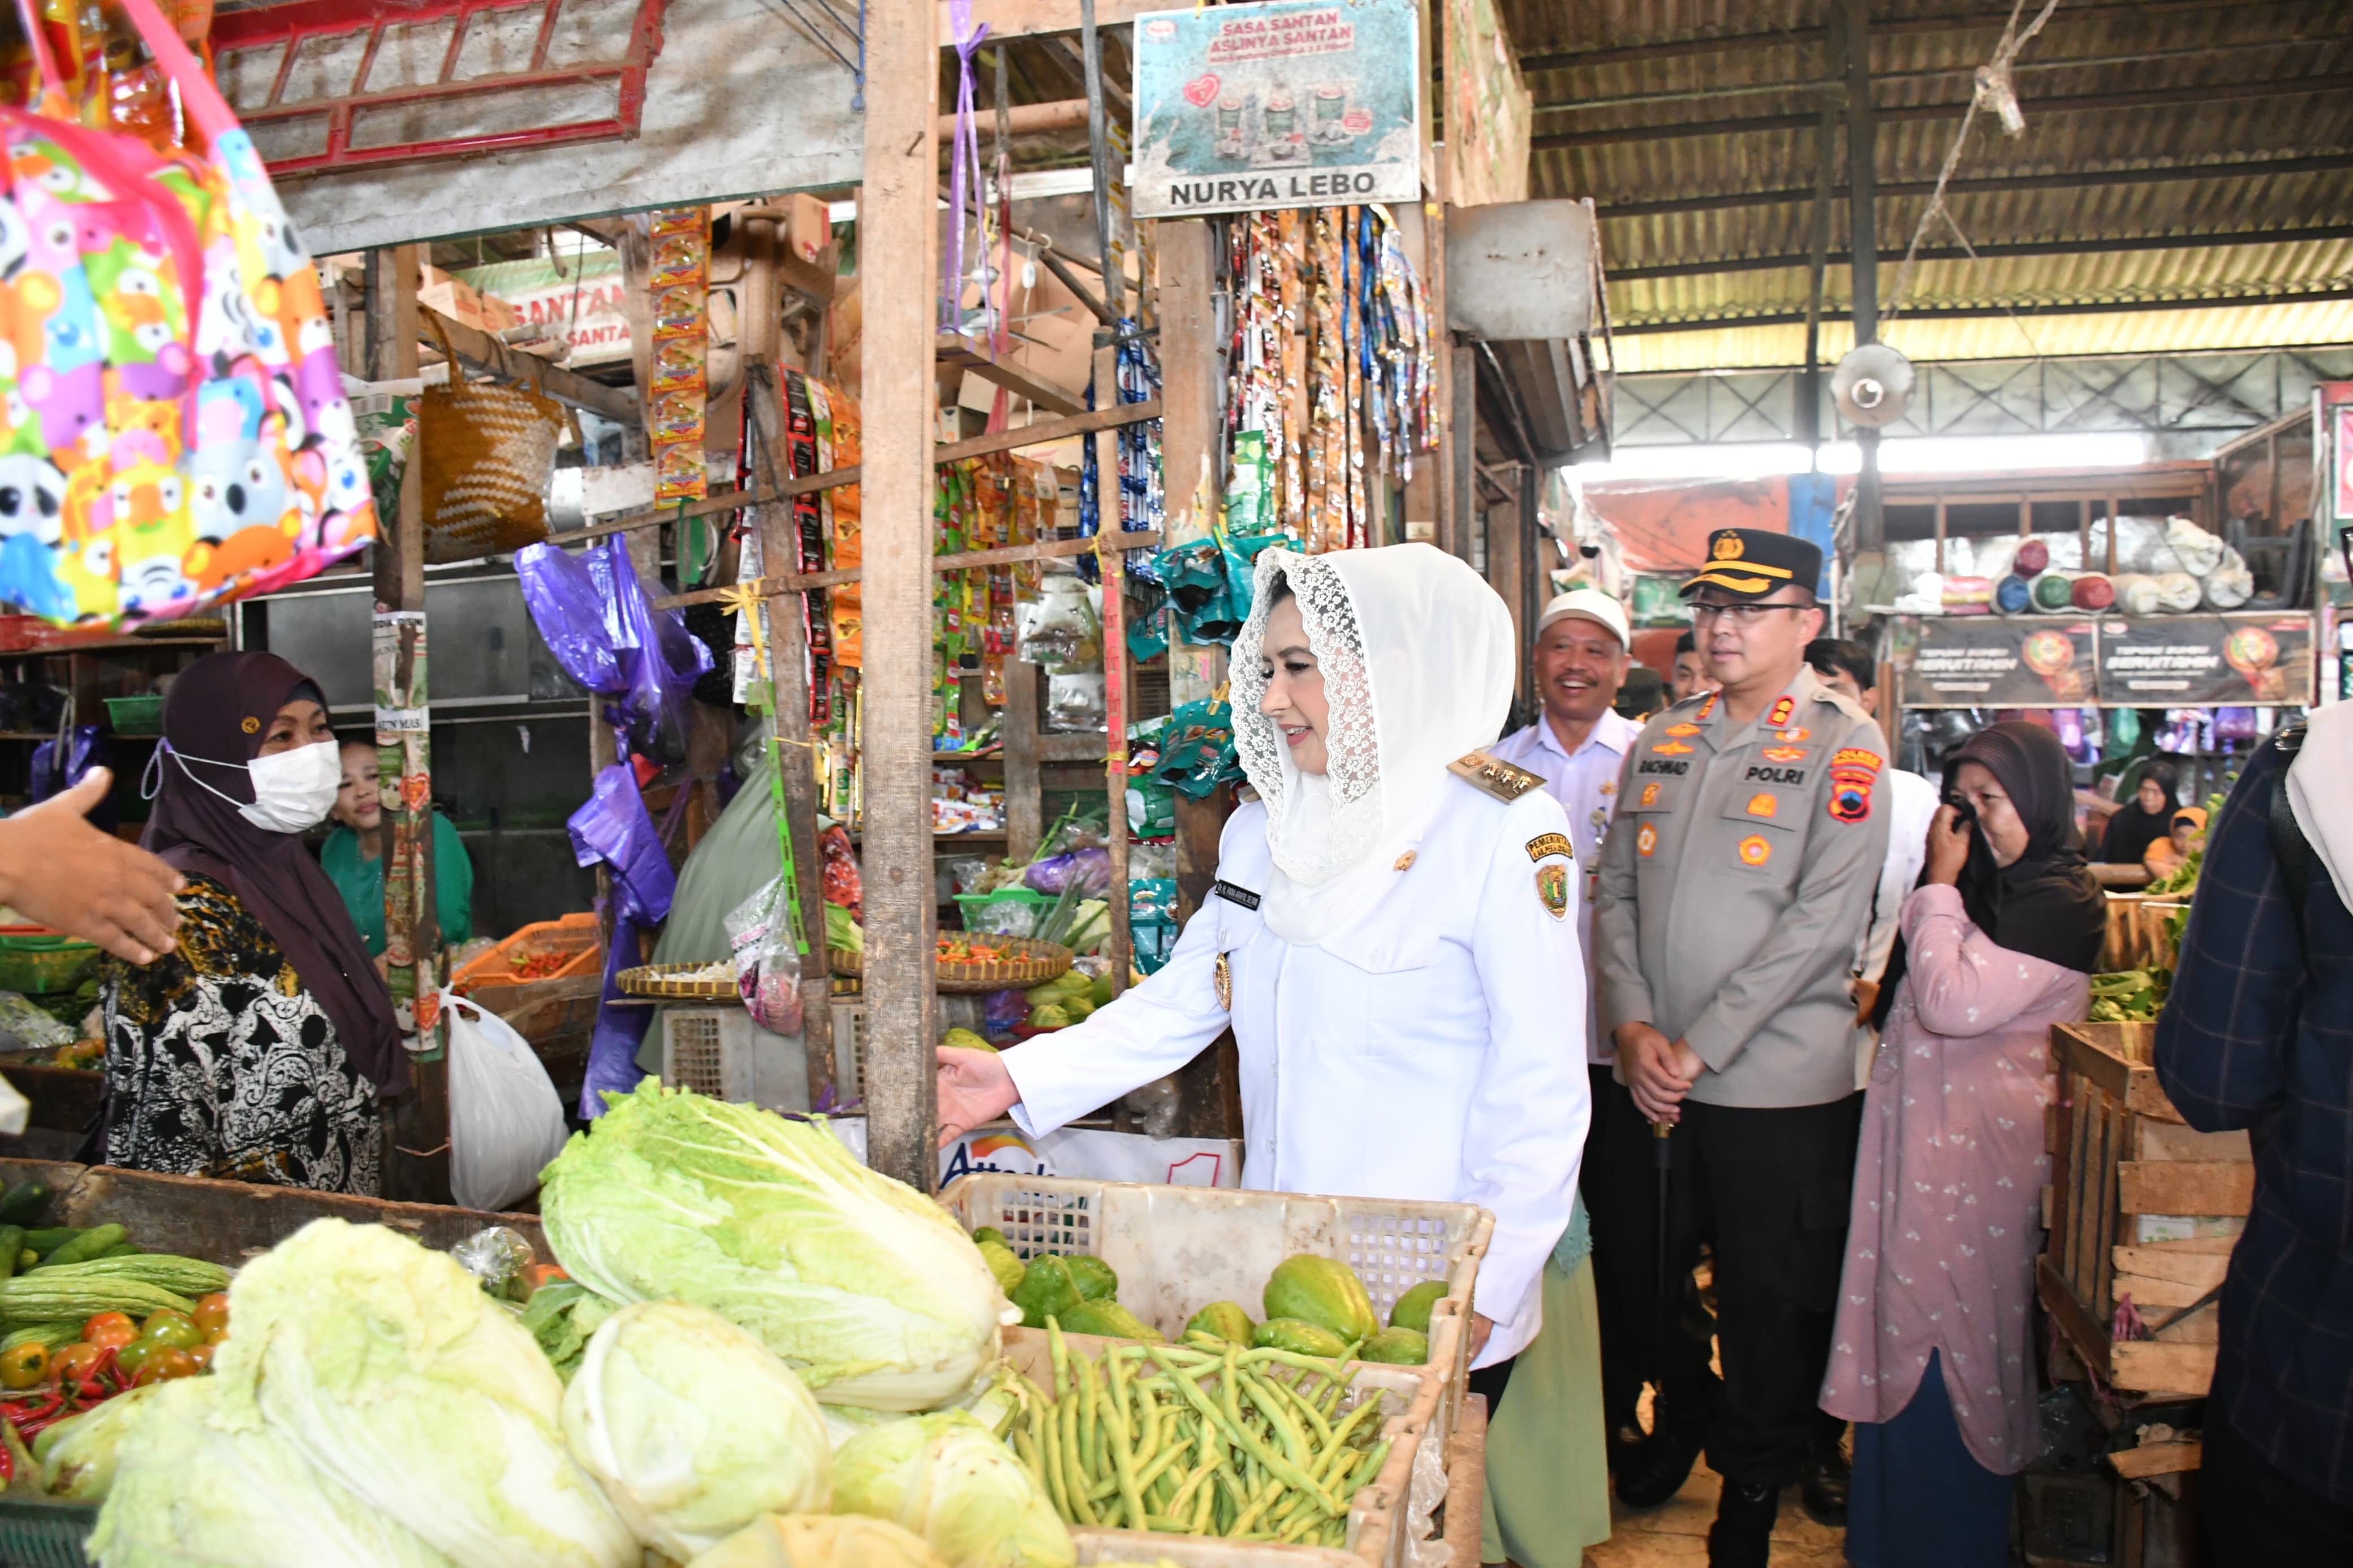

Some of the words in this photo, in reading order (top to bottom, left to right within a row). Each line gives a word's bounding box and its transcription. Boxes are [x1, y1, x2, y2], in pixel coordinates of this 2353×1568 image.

[1223, 20, 1265, 36] SASA
[1270, 12, 1338, 31] SANTAN
[1209, 34, 1279, 53] ASLINYA
[1283, 27, 1351, 45] SANTAN
[1171, 178, 1278, 205] NURYA
[1290, 172, 1375, 198] LEBO
[1745, 766, 1807, 785] POLRI
